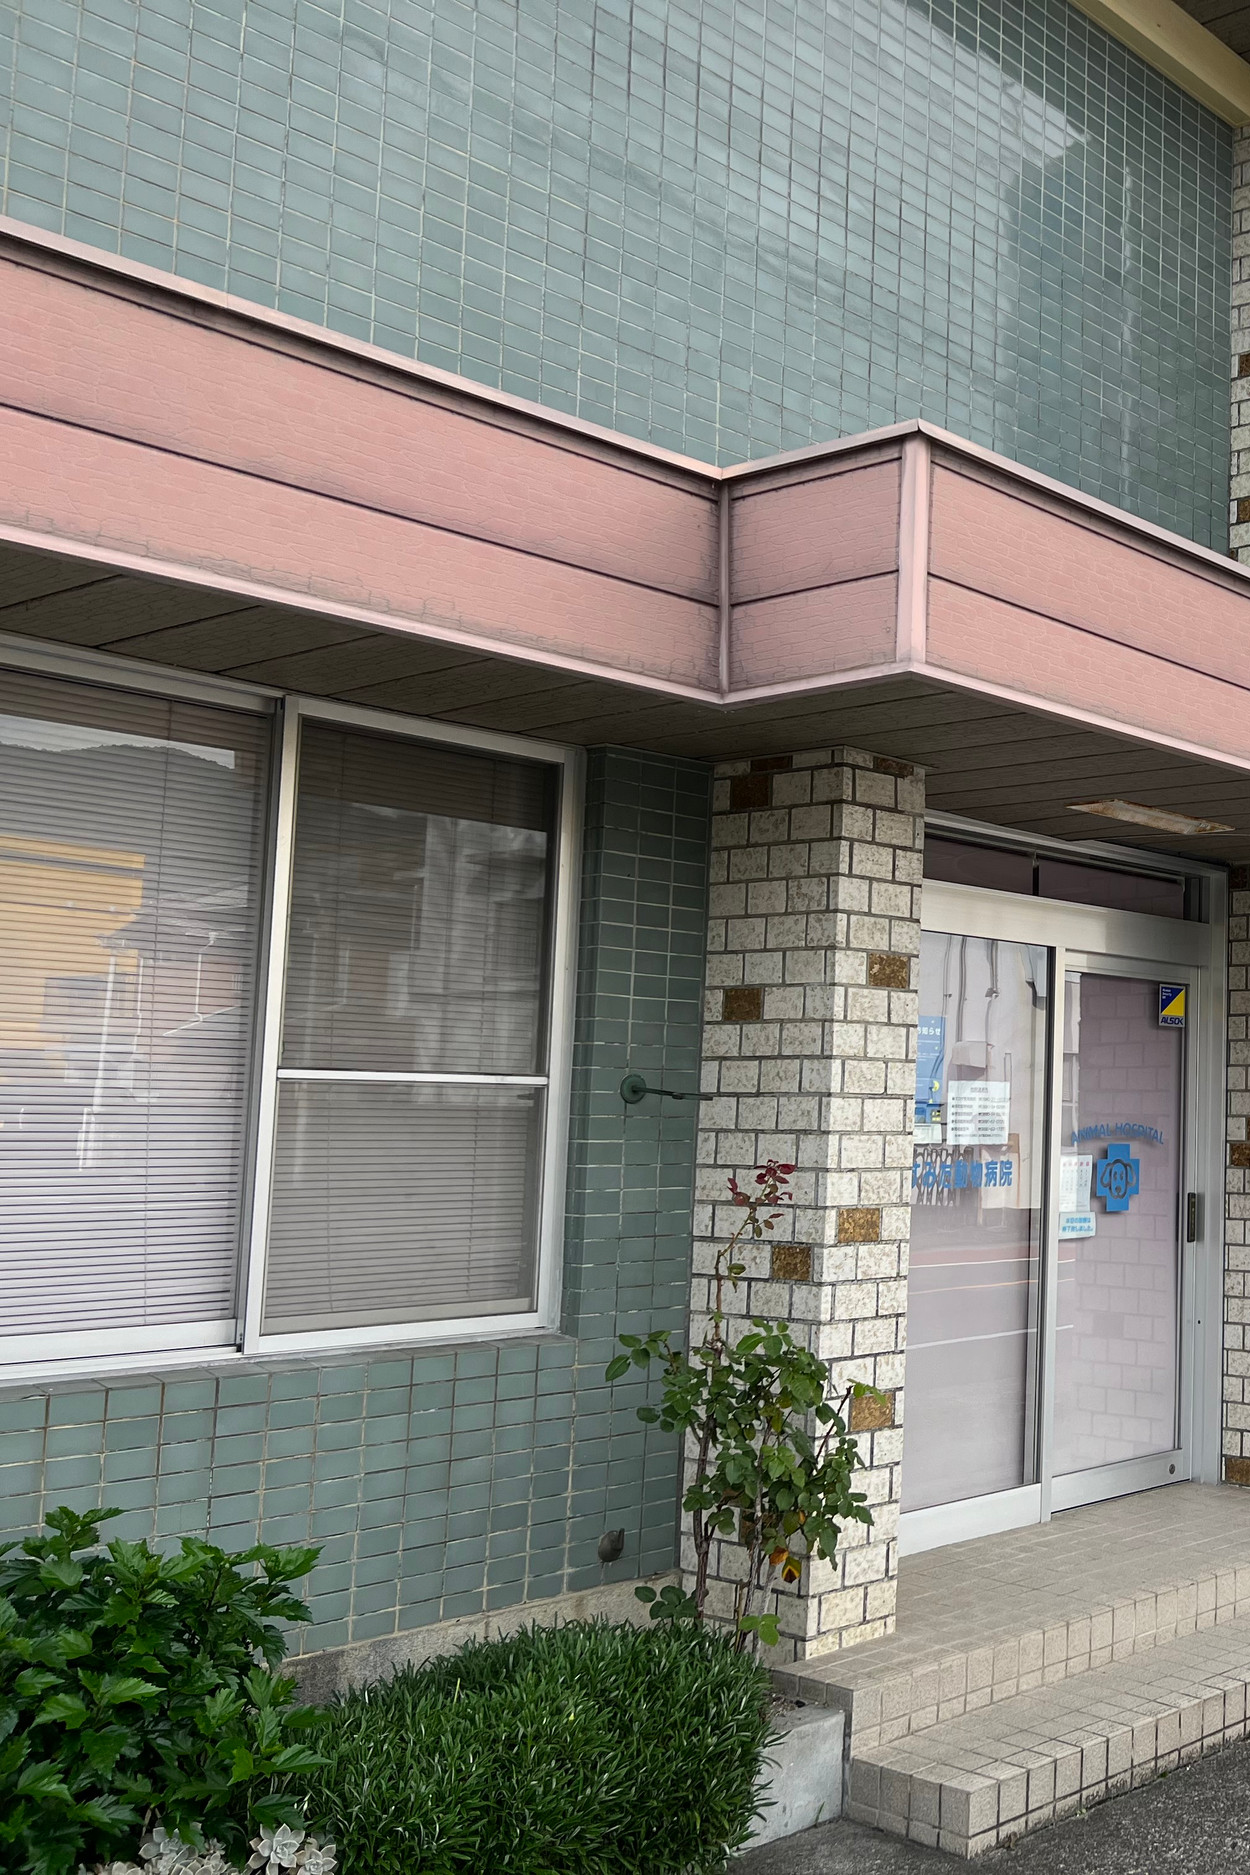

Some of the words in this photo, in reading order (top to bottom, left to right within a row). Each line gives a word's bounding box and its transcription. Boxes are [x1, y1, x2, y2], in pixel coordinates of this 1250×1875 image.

[1160, 1016, 1184, 1026] ALSOK
[1071, 1123, 1111, 1145] ANIMAL
[1115, 1122, 1164, 1145] HOSPITAL
